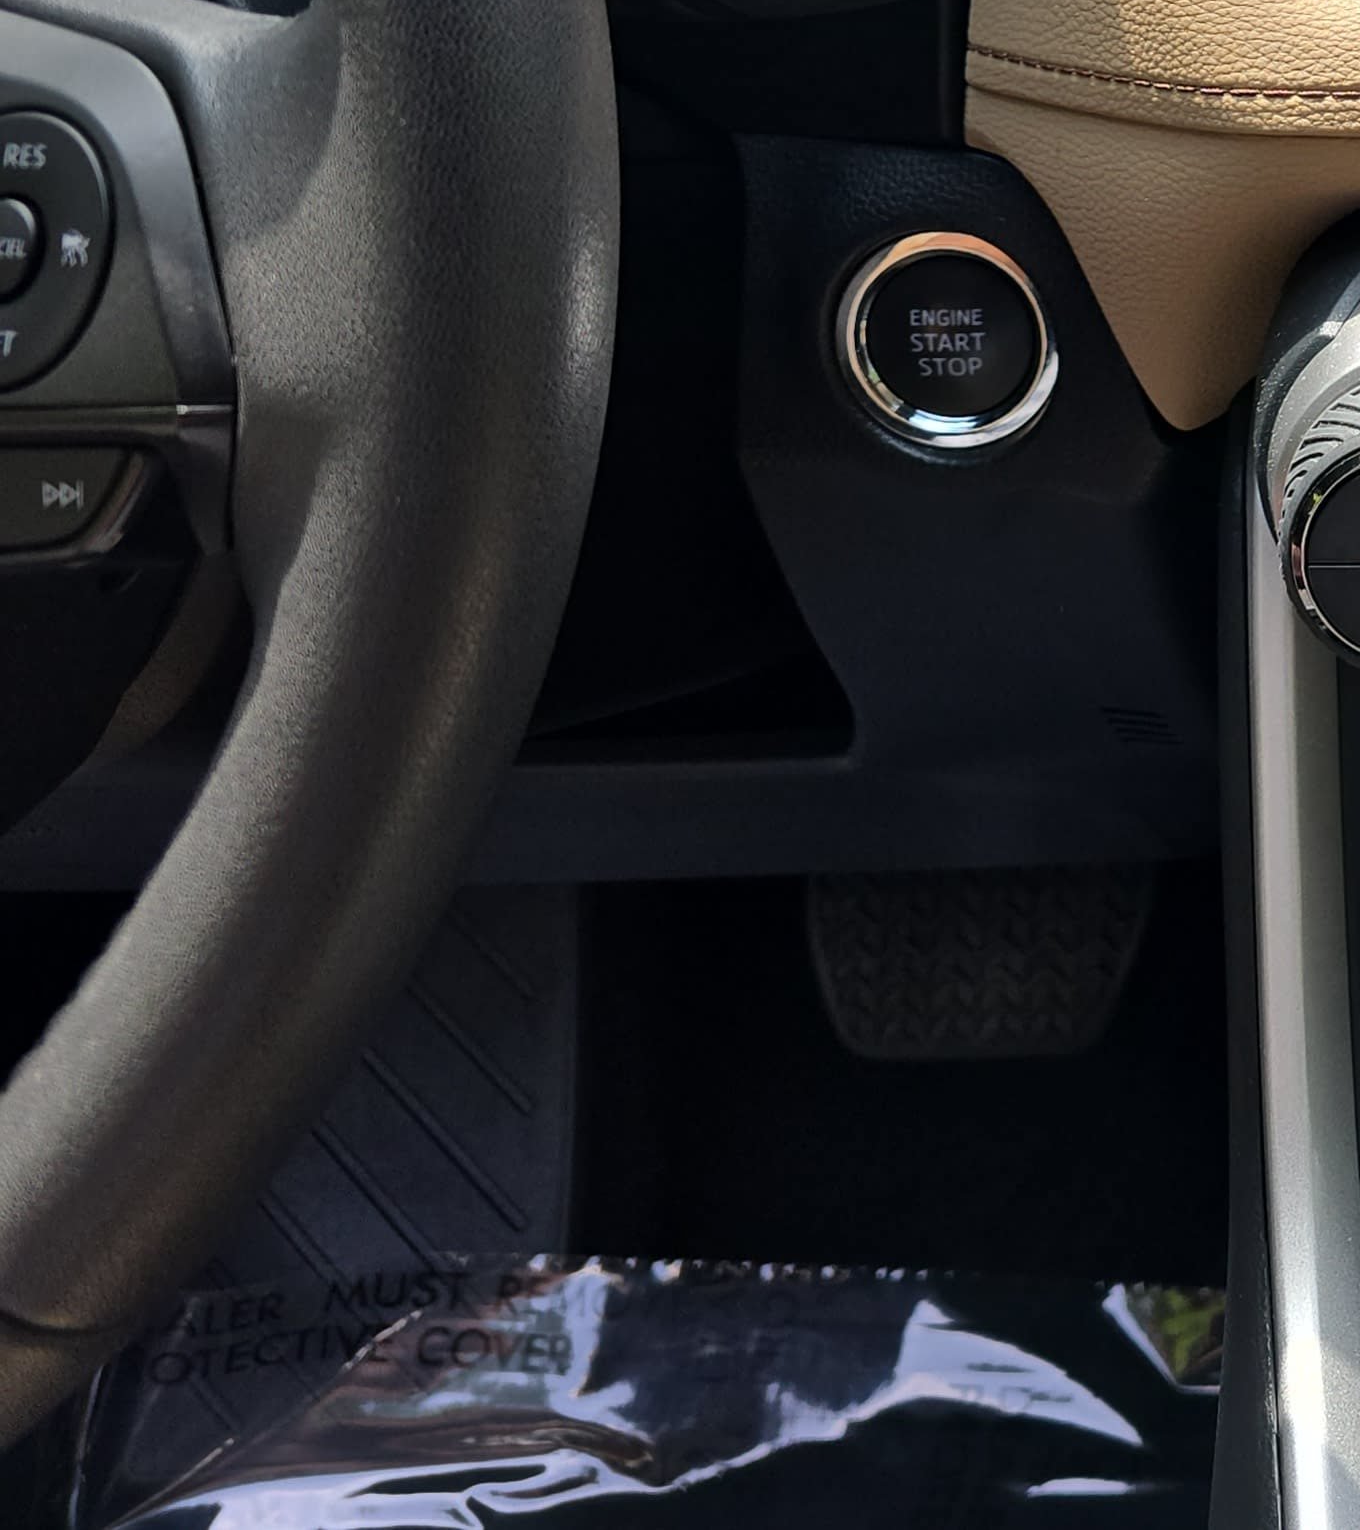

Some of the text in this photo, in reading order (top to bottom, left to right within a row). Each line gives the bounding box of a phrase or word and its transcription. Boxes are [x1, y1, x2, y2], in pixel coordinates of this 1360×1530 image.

[909, 308, 984, 327] ENGINE
[909, 331, 986, 353] START
[918, 357, 983, 377] STOP
[325, 1270, 475, 1313] MUST
[416, 1326, 573, 1377] COVER
